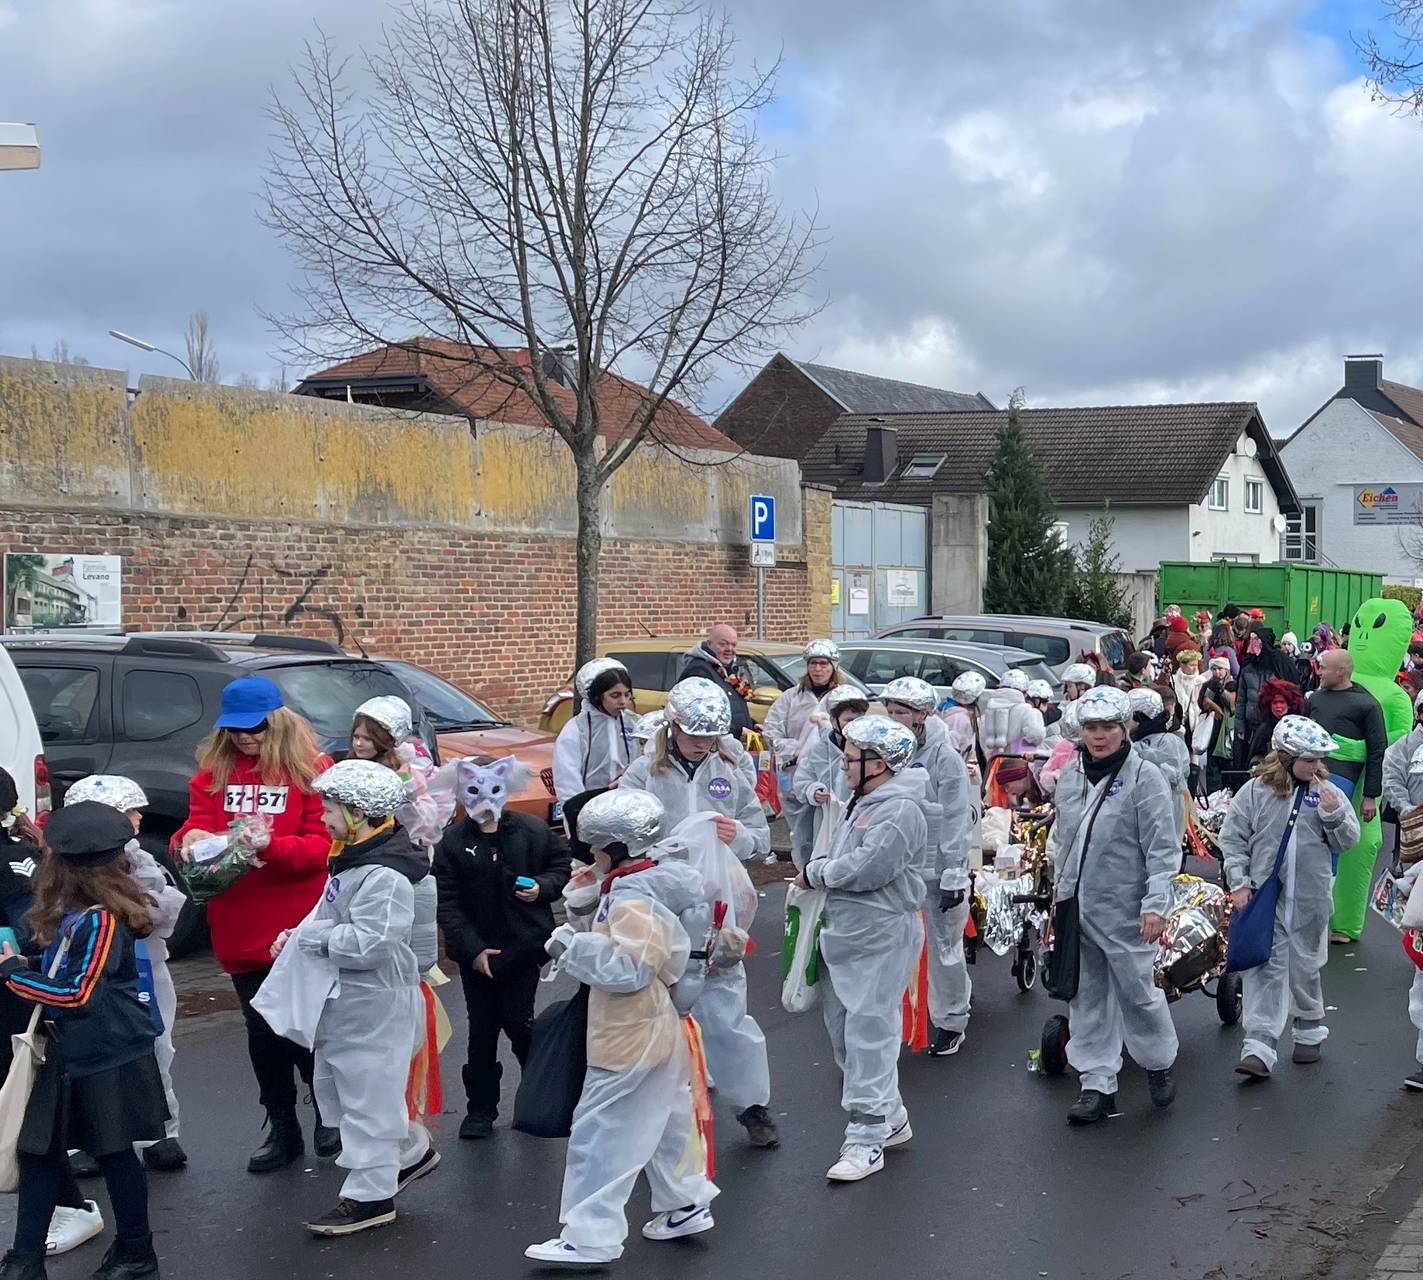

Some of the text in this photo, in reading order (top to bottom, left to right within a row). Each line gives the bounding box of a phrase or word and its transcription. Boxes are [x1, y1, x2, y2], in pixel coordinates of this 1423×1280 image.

[1363, 493, 1398, 502] Eichen
[754, 501, 768, 535] P
[83, 573, 110, 581] Levano
